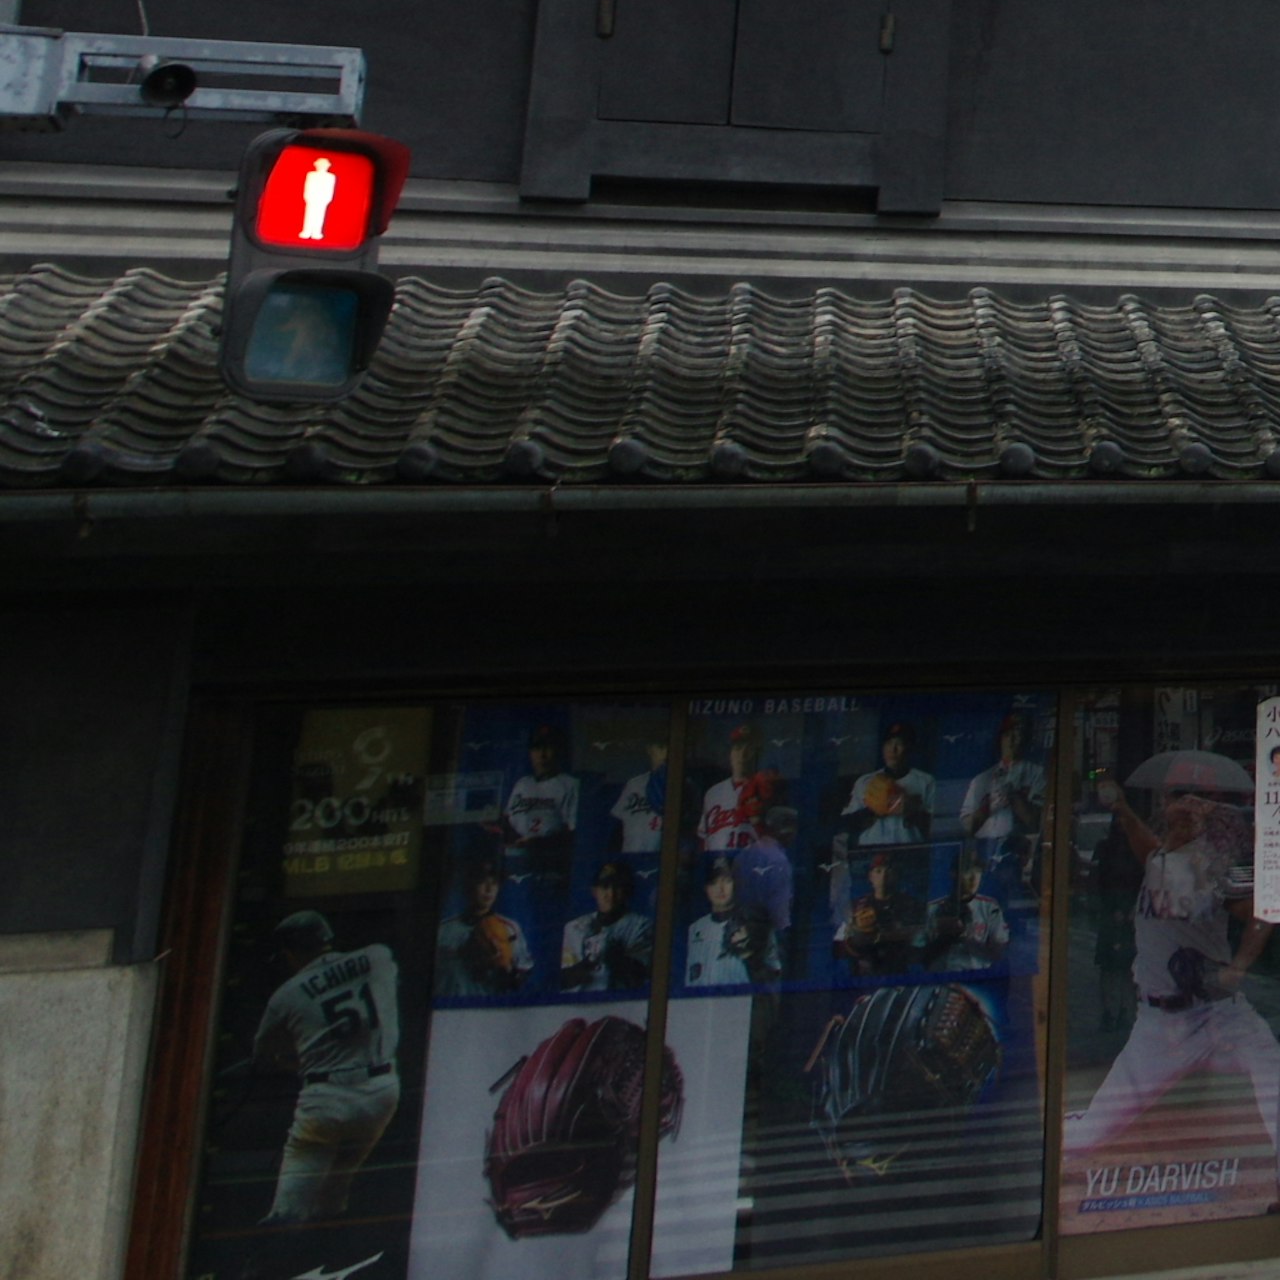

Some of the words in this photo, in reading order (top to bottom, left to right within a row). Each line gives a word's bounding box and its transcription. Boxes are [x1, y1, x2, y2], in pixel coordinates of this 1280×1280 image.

[764, 695, 861, 713] BASEBALL
[289, 797, 371, 832] 200
[282, 854, 331, 875] MLB
[300, 953, 373, 999] ICHIRO
[321, 986, 380, 1040] 51
[1085, 1166, 1120, 1197] YU
[1126, 1157, 1240, 1195] DARVISH
